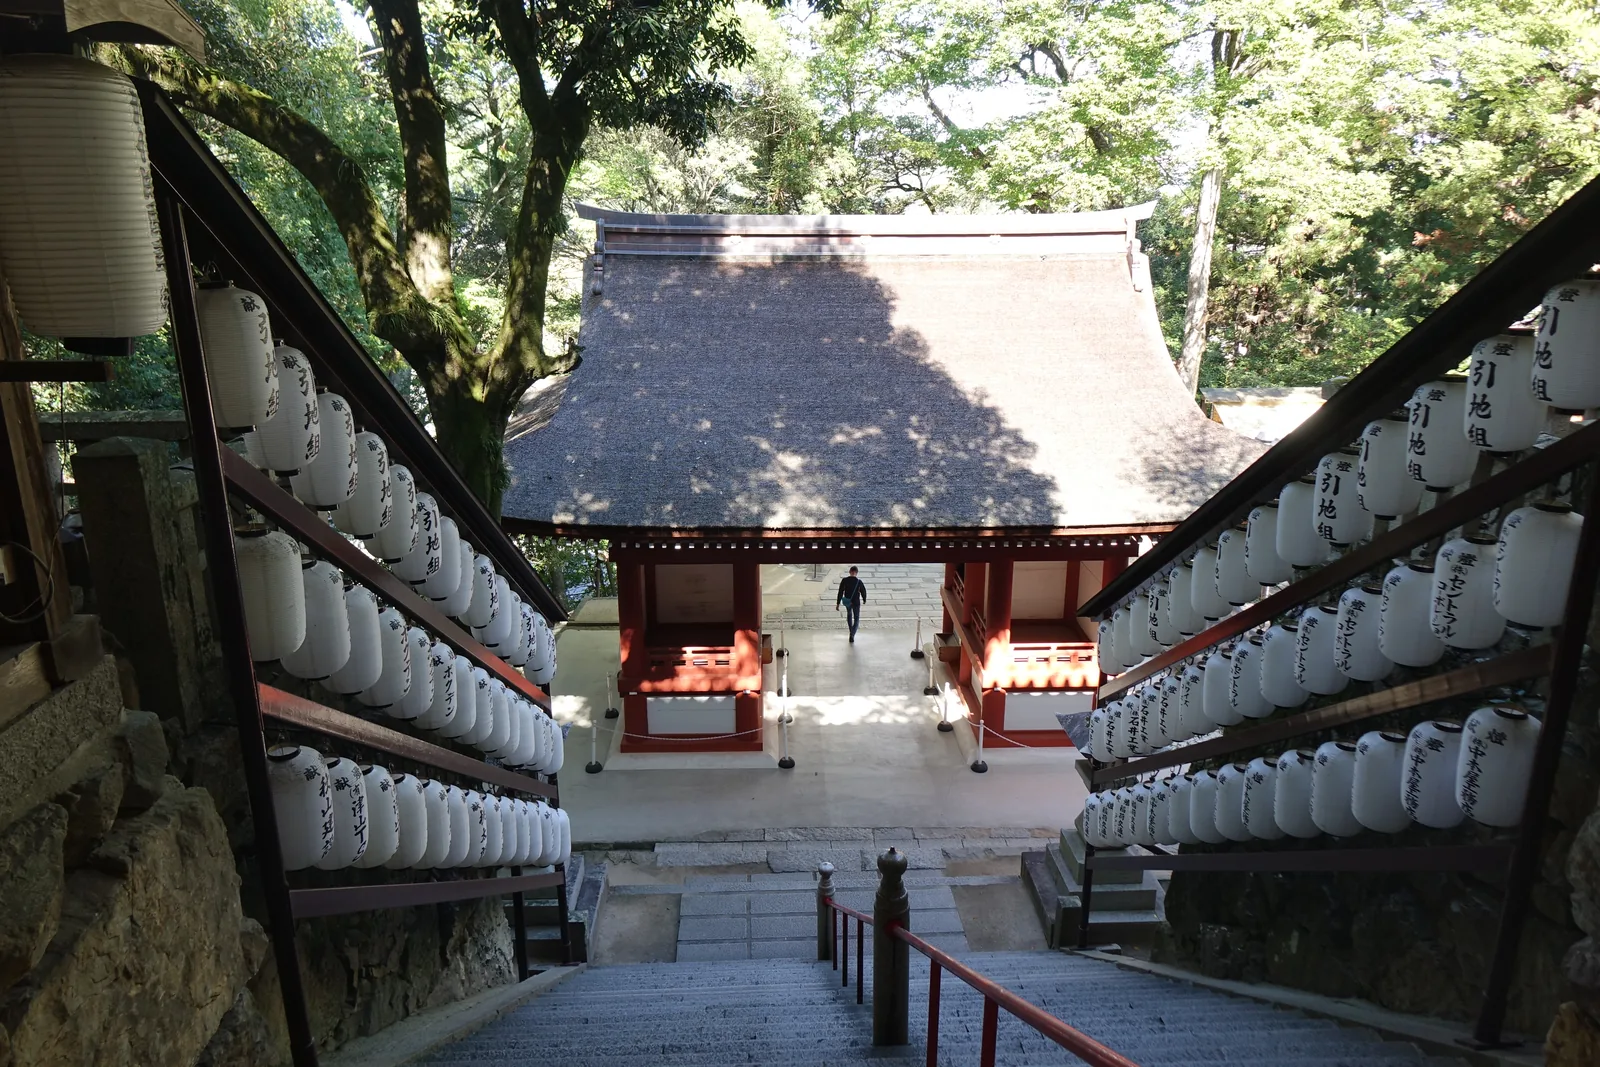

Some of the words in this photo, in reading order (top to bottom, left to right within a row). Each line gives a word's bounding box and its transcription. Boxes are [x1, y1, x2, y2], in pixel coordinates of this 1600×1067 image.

[1532, 304, 1561, 402] 引地組
[1467, 359, 1498, 449] 引地組
[1407, 402, 1432, 483] 引地組
[423, 508, 441, 576] 引地組
[1317, 472, 1342, 542] 引地組
[1148, 594, 1161, 641] 引地組
